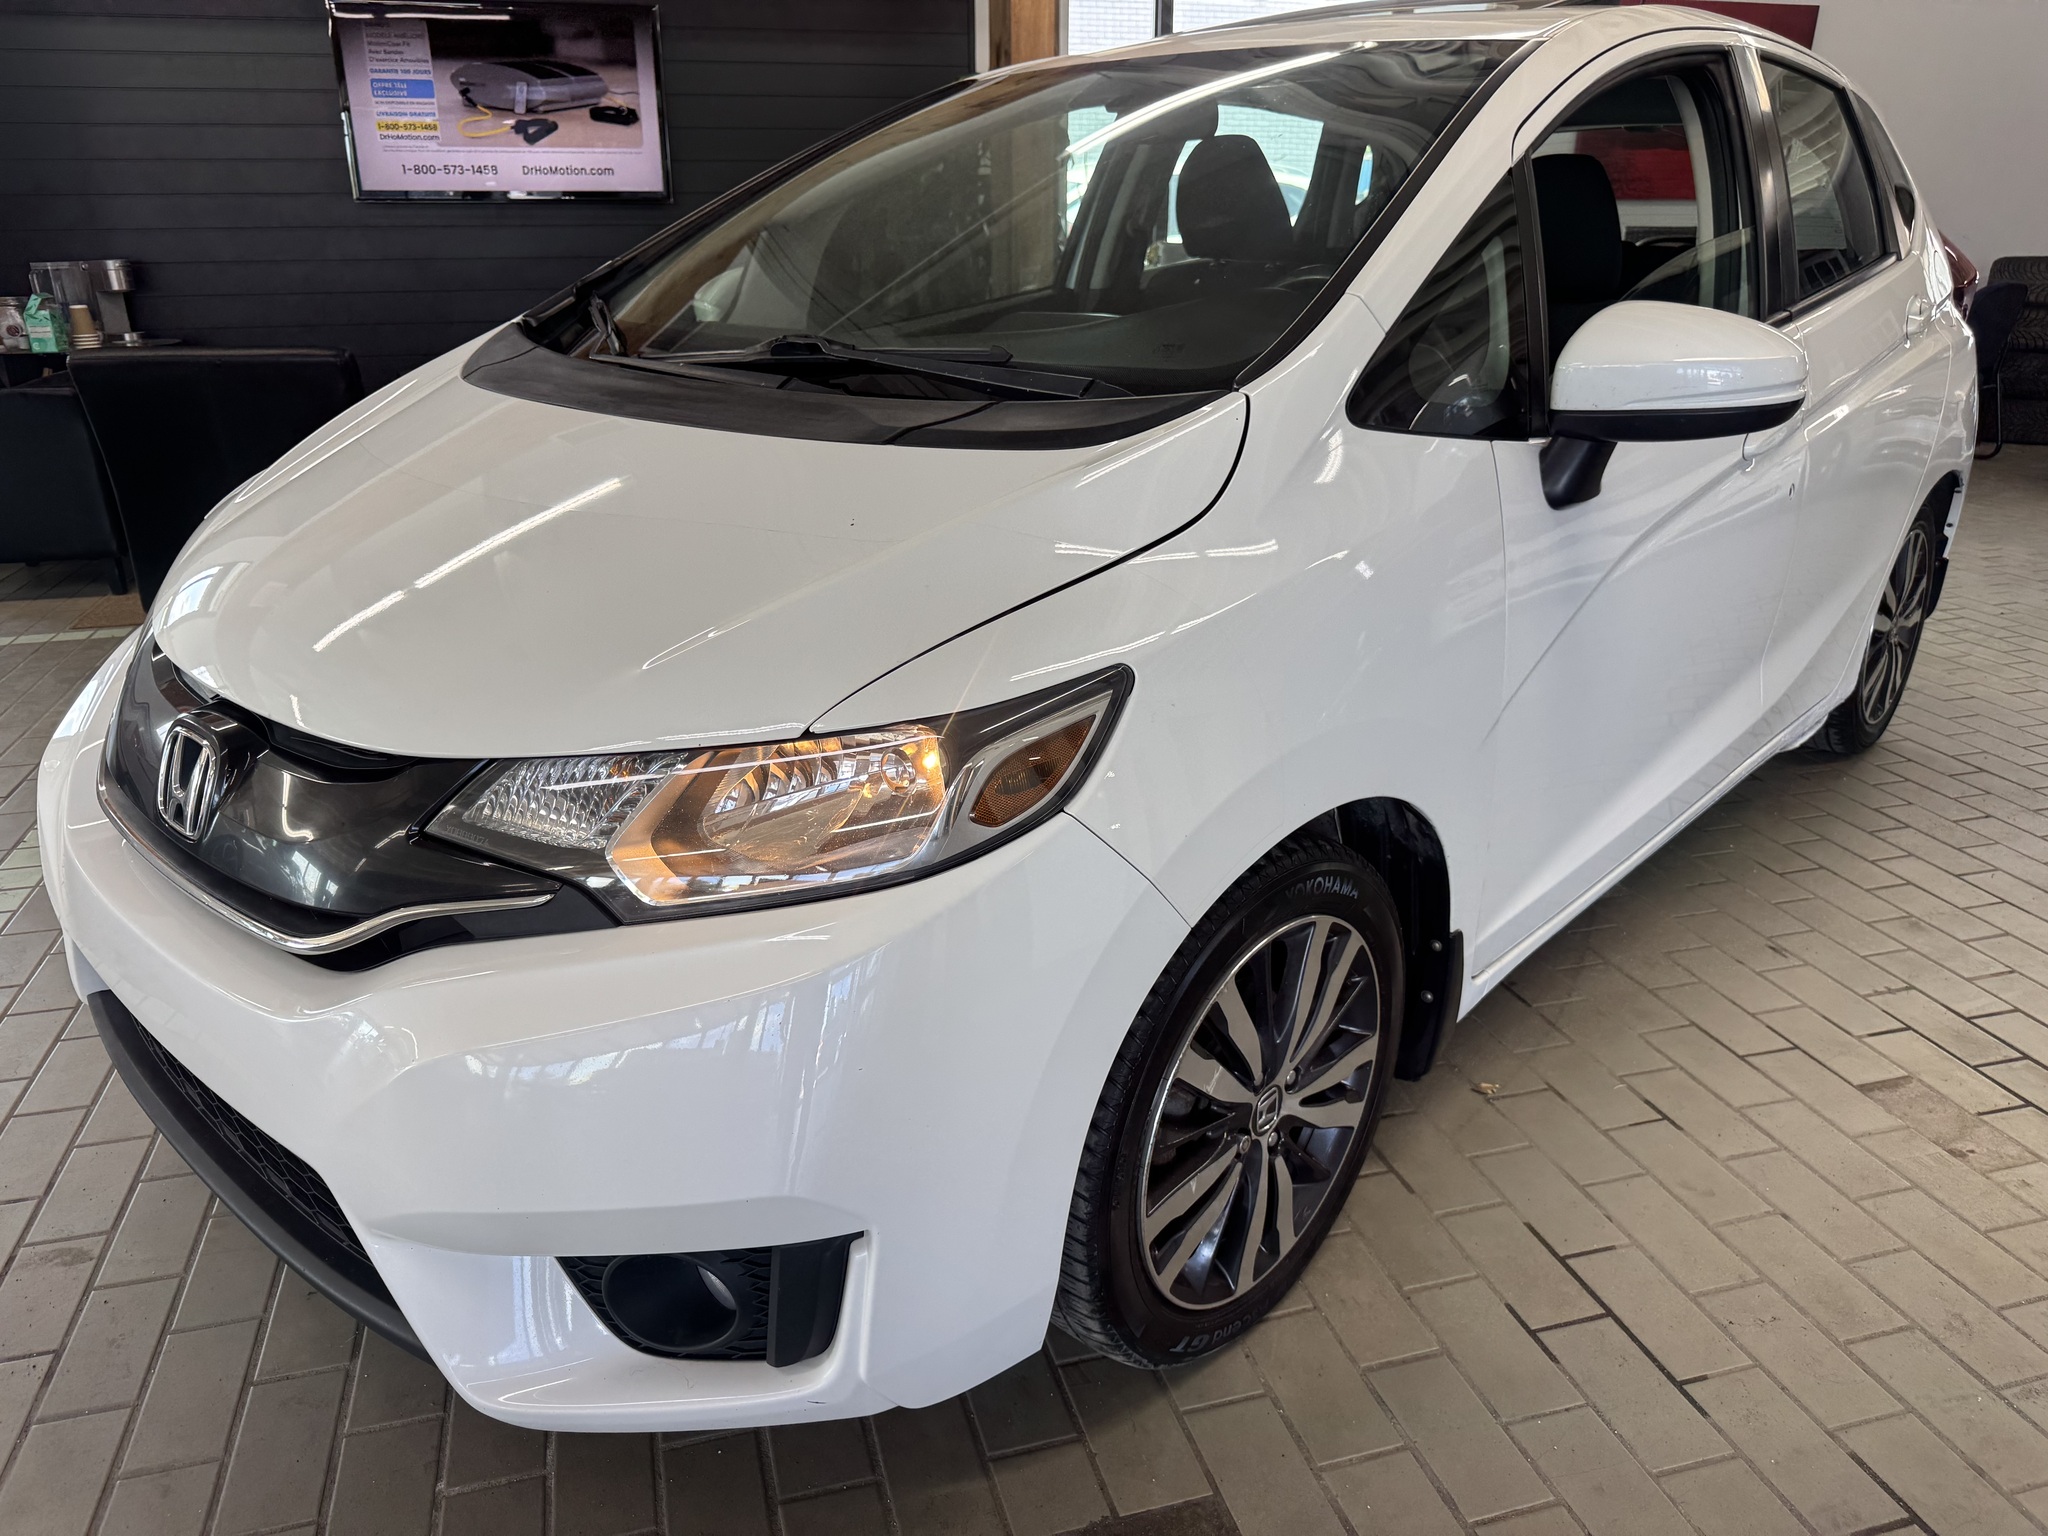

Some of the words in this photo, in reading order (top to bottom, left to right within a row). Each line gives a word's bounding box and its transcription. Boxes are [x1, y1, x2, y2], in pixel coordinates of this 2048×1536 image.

[377, 123, 438, 131] 1-800-573-1458
[379, 133, 441, 141] DrHoMotion.com
[401, 164, 498, 176] 1-800-573-1458
[522, 165, 615, 176] DrHoMotion.com
[1285, 875, 1359, 899] YOKOHAMA
[1168, 1334, 1210, 1353] GT
